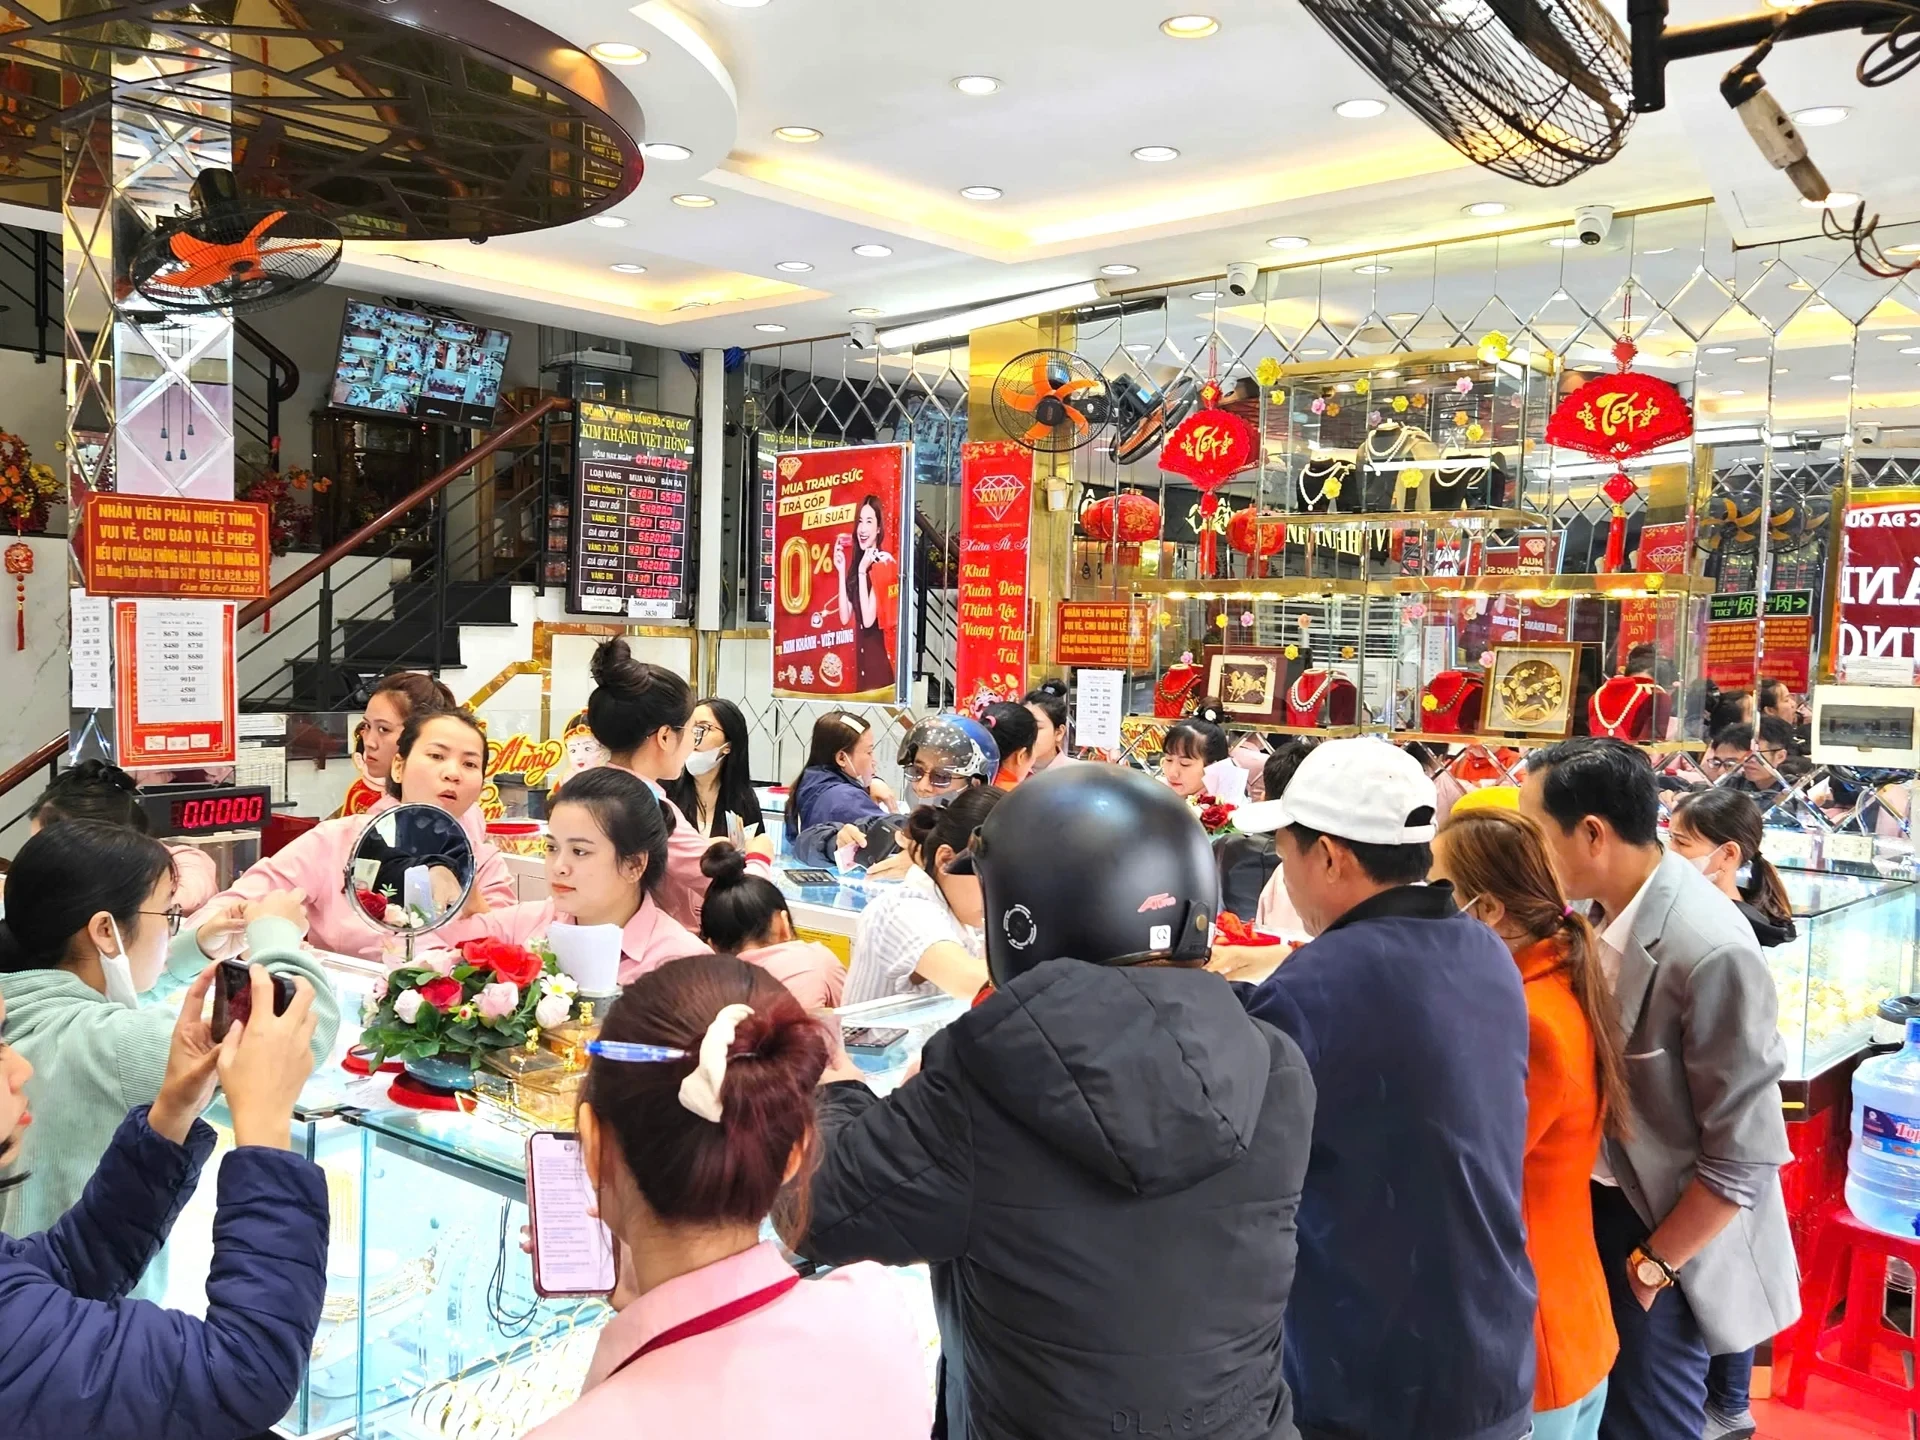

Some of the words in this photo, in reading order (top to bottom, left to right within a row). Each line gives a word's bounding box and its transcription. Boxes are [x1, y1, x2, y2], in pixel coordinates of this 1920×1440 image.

[1596, 392, 1643, 436] Tết
[581, 423, 601, 440] KIM
[603, 425, 638, 446] KHÁNH
[640, 429, 663, 451] VIỆT
[589, 468, 604, 479] LOẠI
[605, 469, 622, 480] VÀNG
[629, 474, 643, 483] MUA
[644, 474, 656, 484] VÀO
[661, 477, 673, 486] BÁN
[674, 479, 682, 488] RA
[781, 481, 804, 496] MUA
[805, 474, 840, 491] TRANG
[841, 467, 864, 485] SỨC
[617, 487, 624, 495] TY
[782, 497, 802, 513] TRẢ
[803, 494, 826, 510] GÓP
[98, 502, 132, 519] NHÂN
[134, 504, 162, 521] VIÊN
[164, 504, 191, 523] PHẢI
[194, 508, 225, 527] NHIỆT
[228, 509, 256, 528] TÌNH,
[807, 512, 823, 526] LÃI
[825, 507, 852, 523] SUẤT
[99, 524, 119, 539] VUI
[122, 521, 140, 542] VẺ,
[143, 526, 166, 541] CHU
[169, 526, 192, 542] ĐÁO
[194, 527, 209, 544] VÀ
[211, 526, 225, 544] LỄ
[227, 529, 256, 546] PHÉP
[95, 541, 111, 560] NẾU
[128, 544, 153, 562] KHÁCH
[959, 538, 990, 552] Xuân
[780, 536, 833, 615] 0%
[962, 563, 990, 578] Khai
[961, 583, 993, 597] Xuân
[998, 580, 1023, 597] Đón
[961, 603, 993, 619] Thịnh
[998, 603, 1018, 623] Lộc
[960, 622, 995, 641] Vượng
[997, 647, 1018, 664] Tài
